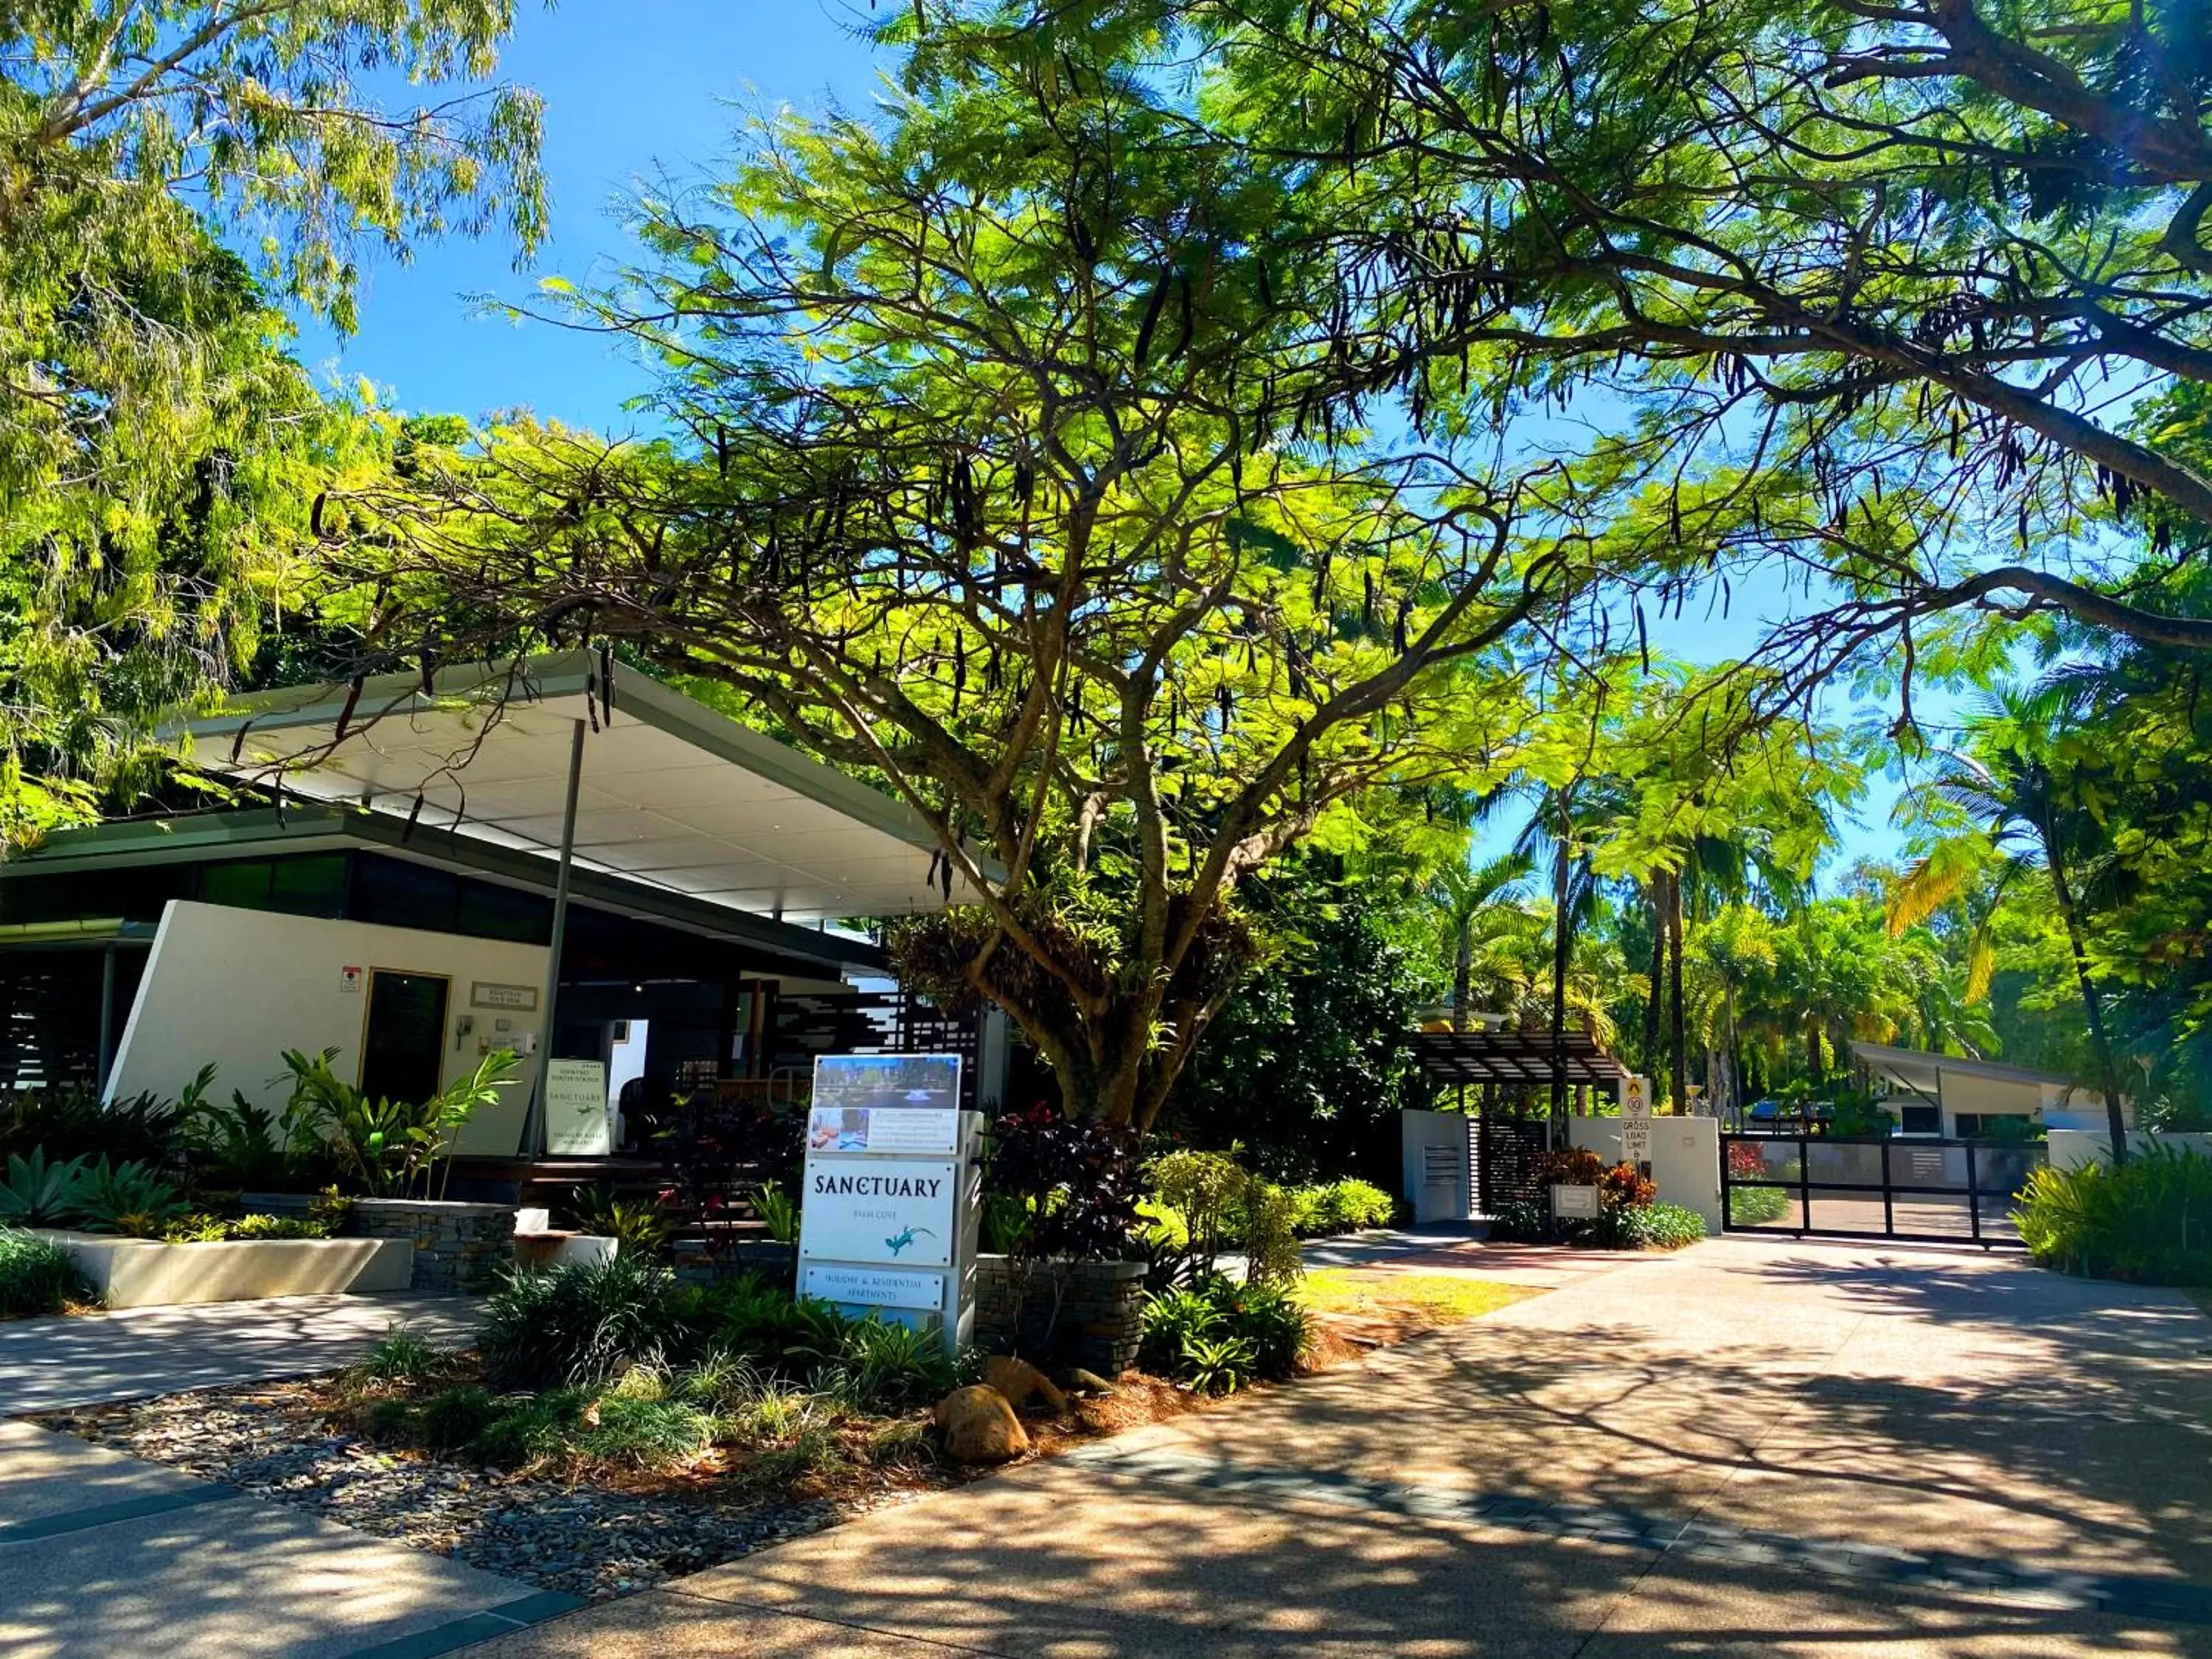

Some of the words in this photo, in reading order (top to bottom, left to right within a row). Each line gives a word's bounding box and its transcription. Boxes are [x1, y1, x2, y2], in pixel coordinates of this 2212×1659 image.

[549, 1092, 600, 1102] SANCTUARY
[1623, 1121, 1649, 1130] GROSS
[1627, 1141, 1646, 1149] LIMIT
[815, 1175, 941, 1198] SANCTUARY
[825, 1274, 858, 1284] HOLIDAY
[872, 1277, 921, 1289] RESIDENTIAL
[849, 1289, 897, 1300] APARTMENTS
